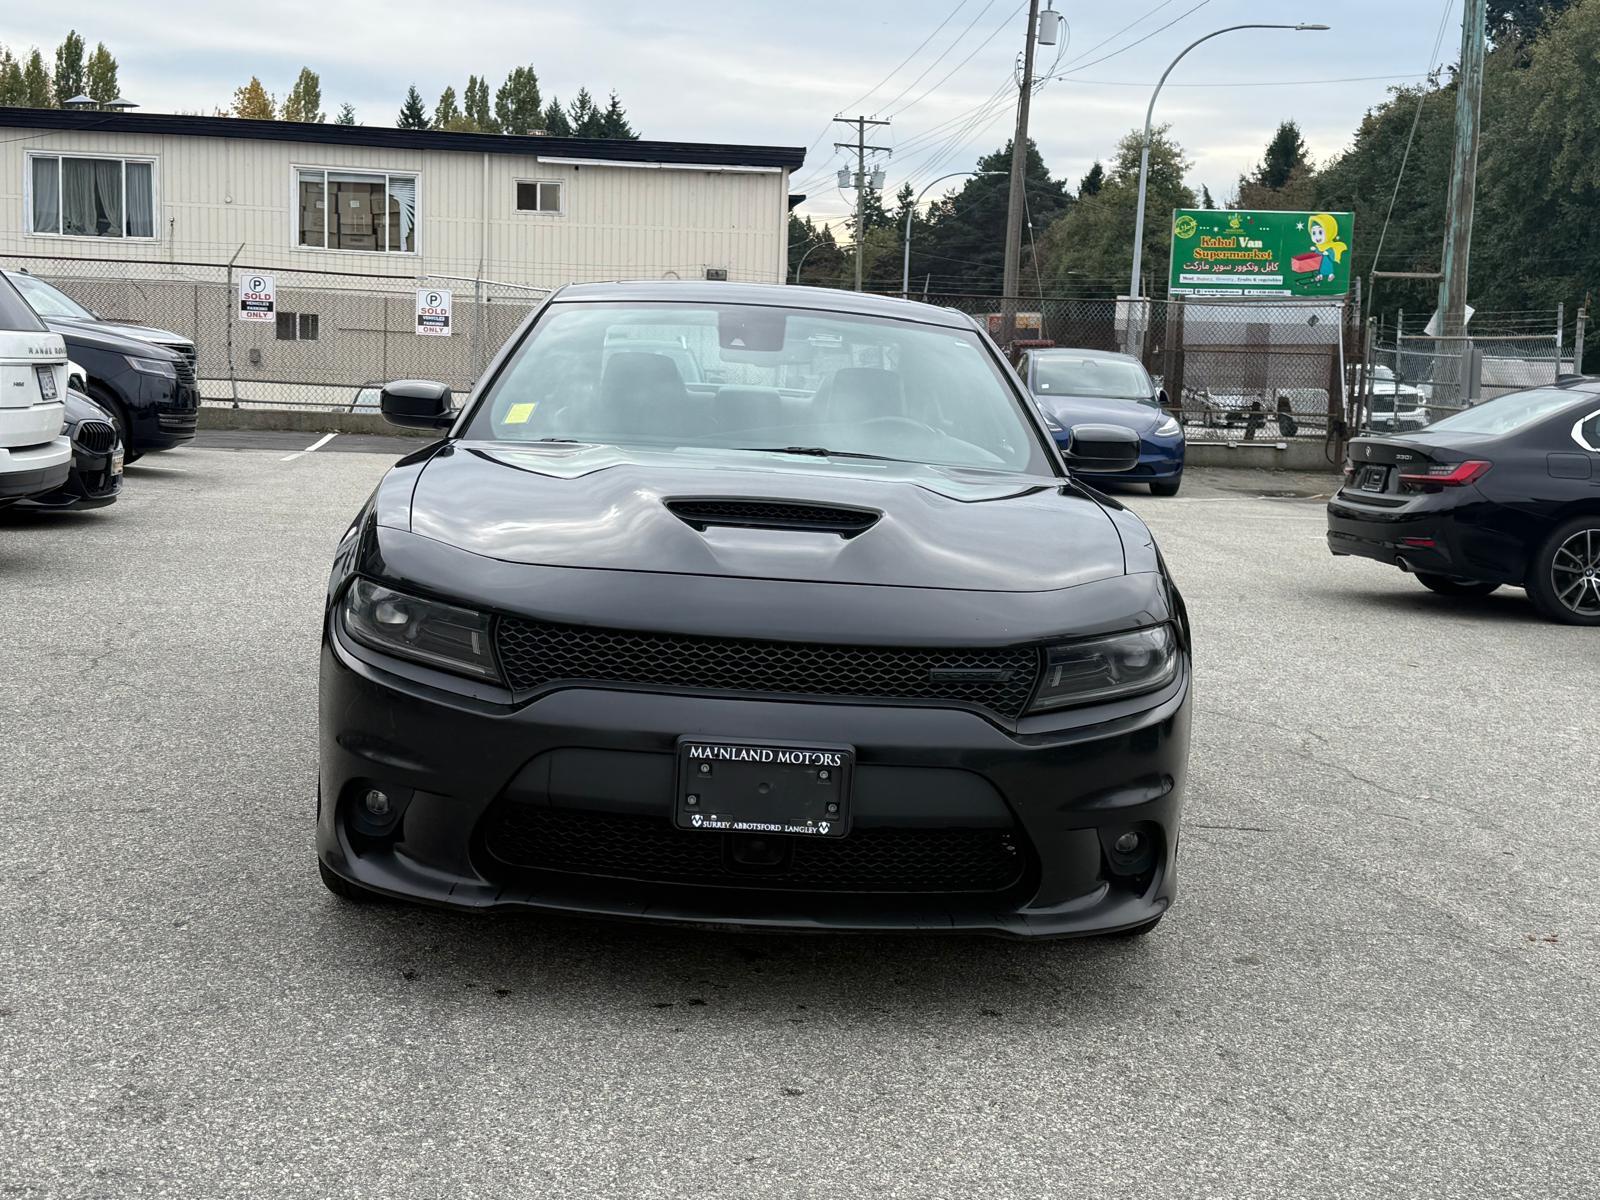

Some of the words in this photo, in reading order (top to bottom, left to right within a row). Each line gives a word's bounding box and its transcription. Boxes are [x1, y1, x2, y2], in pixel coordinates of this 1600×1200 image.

[1200, 236, 1236, 247] Kabul
[1239, 237, 1263, 248] Van
[1194, 249, 1272, 261] Supermarket
[253, 280, 261, 290] P
[430, 295, 437, 305] P
[777, 751, 841, 767] MOTORS
[703, 821, 731, 829] SURREY
[732, 822, 781, 831] ABBOTSFORD
[784, 825, 818, 834] LANGLEY
